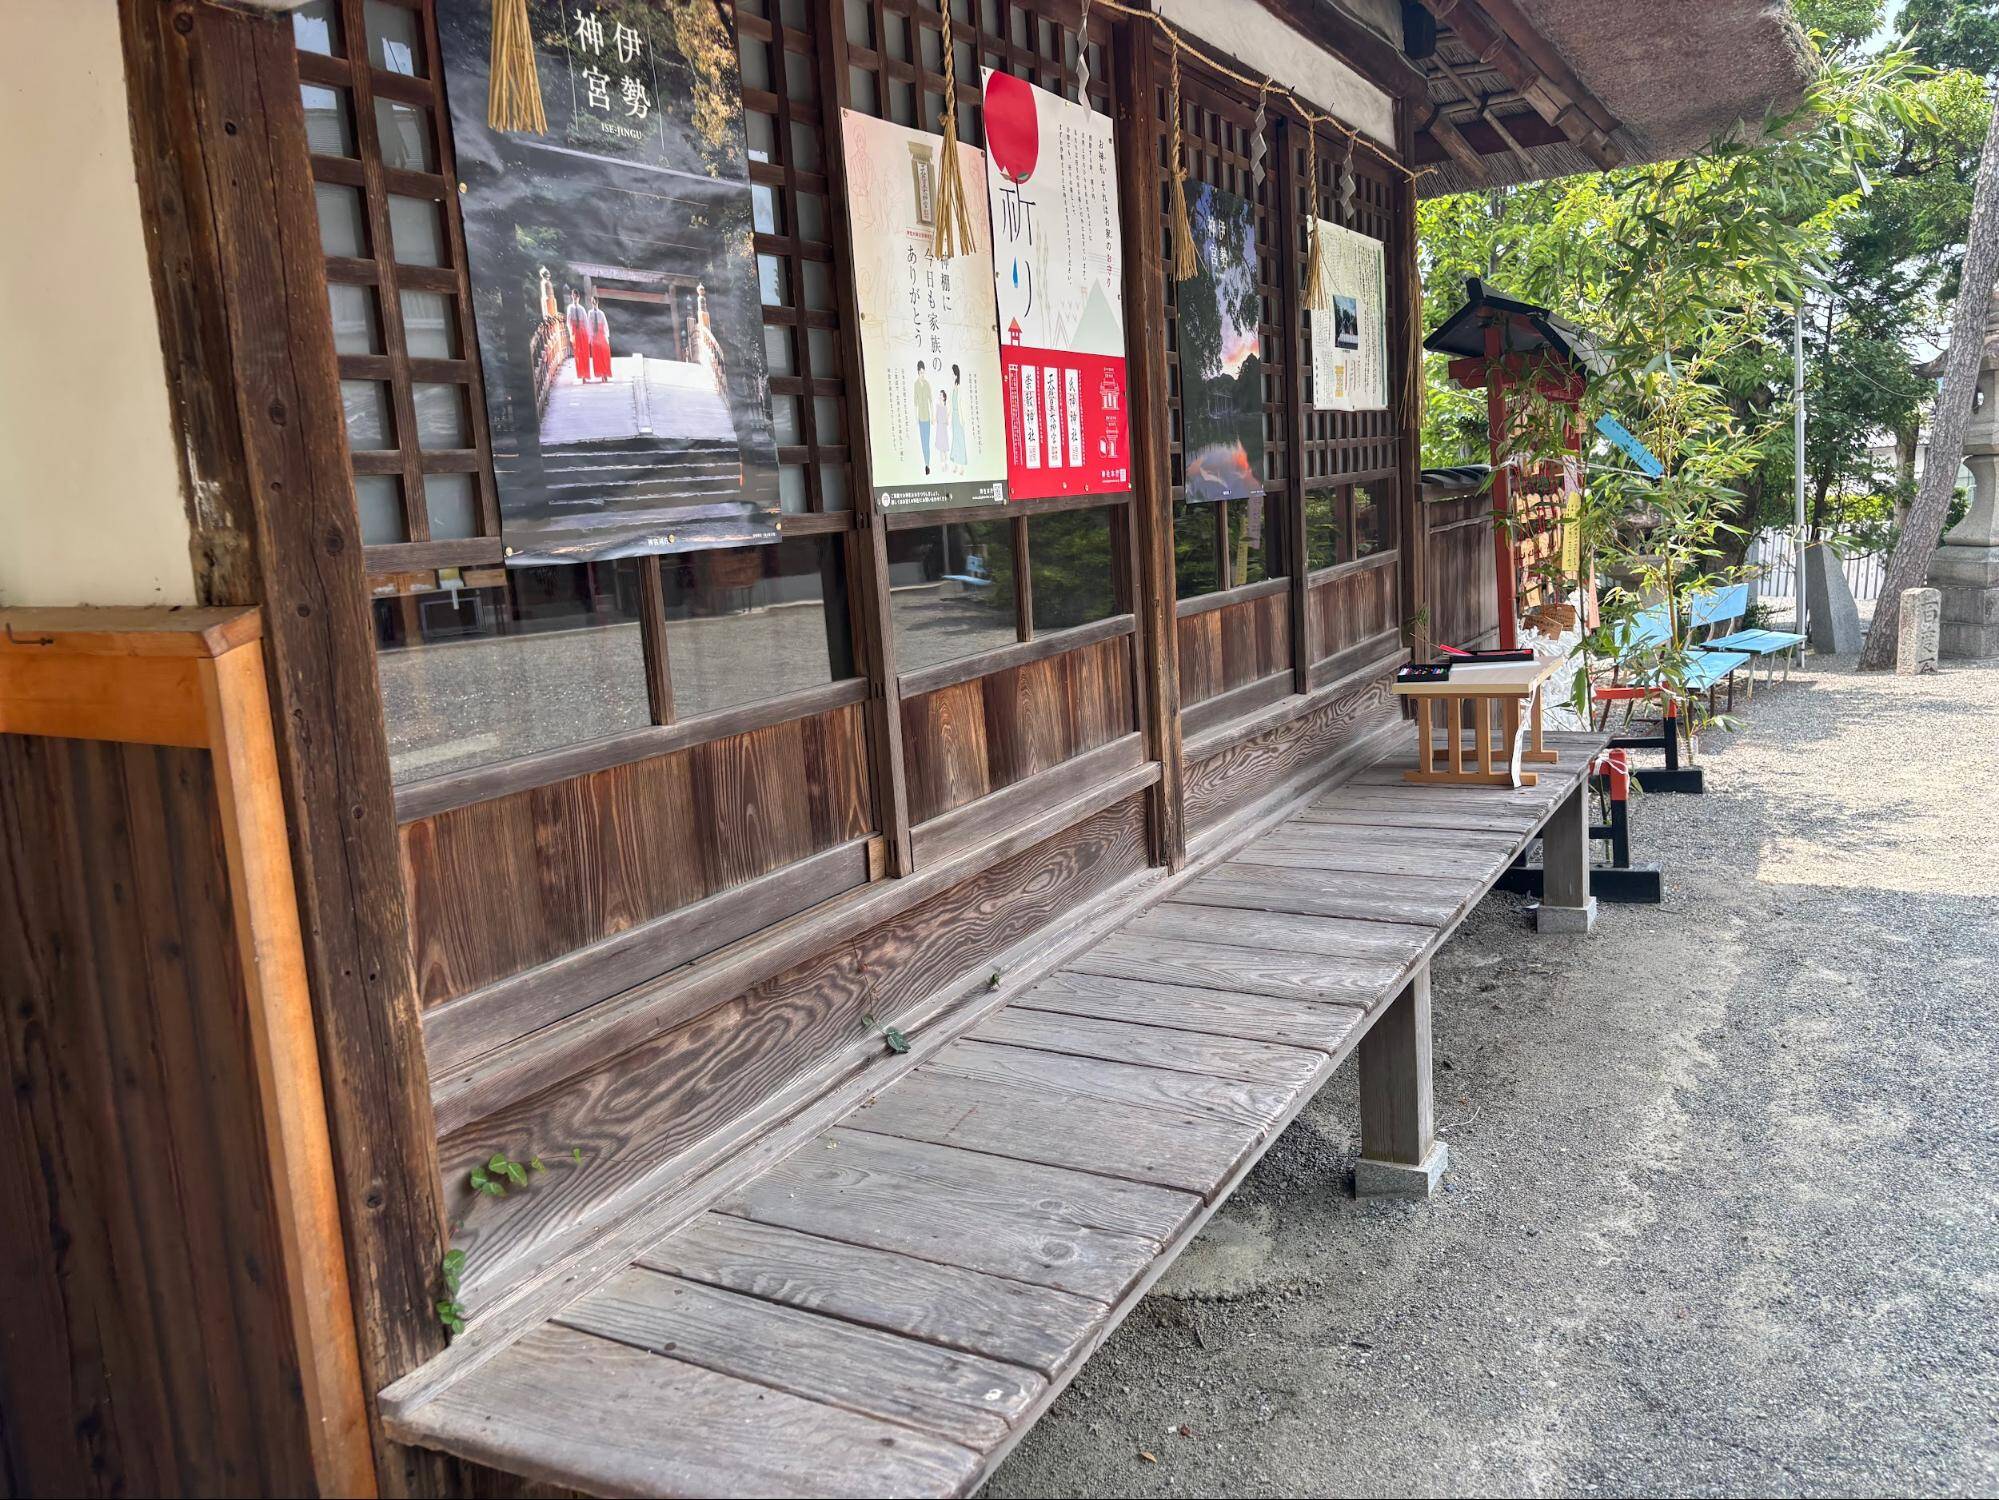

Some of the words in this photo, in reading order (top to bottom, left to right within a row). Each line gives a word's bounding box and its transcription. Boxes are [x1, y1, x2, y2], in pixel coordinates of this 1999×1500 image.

[573, 8, 611, 111] 神宮
[613, 21, 651, 119] 伊勢
[601, 122, 643, 139] ISE-JINGU
[907, 244, 921, 348] ありがとう
[925, 248, 942, 371] 今日も家族の
